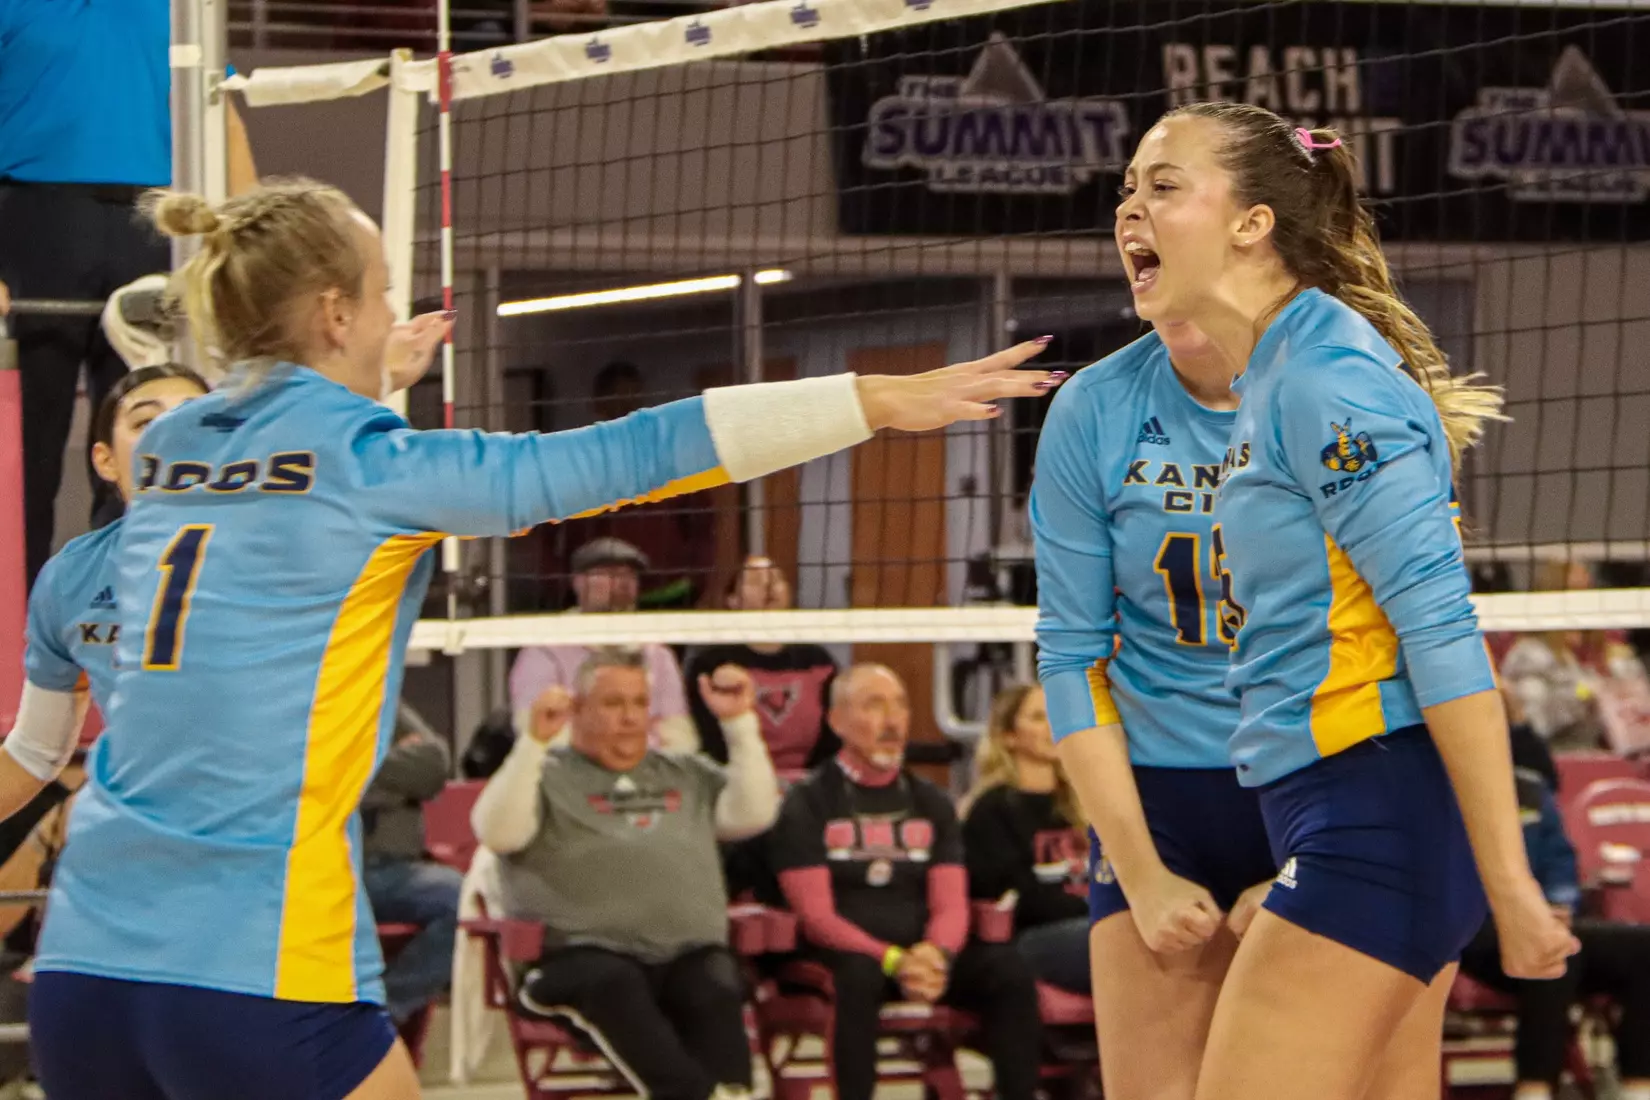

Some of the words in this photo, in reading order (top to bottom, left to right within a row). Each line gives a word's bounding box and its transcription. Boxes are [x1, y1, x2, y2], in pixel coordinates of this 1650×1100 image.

[1163, 44, 1362, 112] REACH
[872, 104, 1117, 158] SUMMIT
[143, 523, 215, 670] 1
